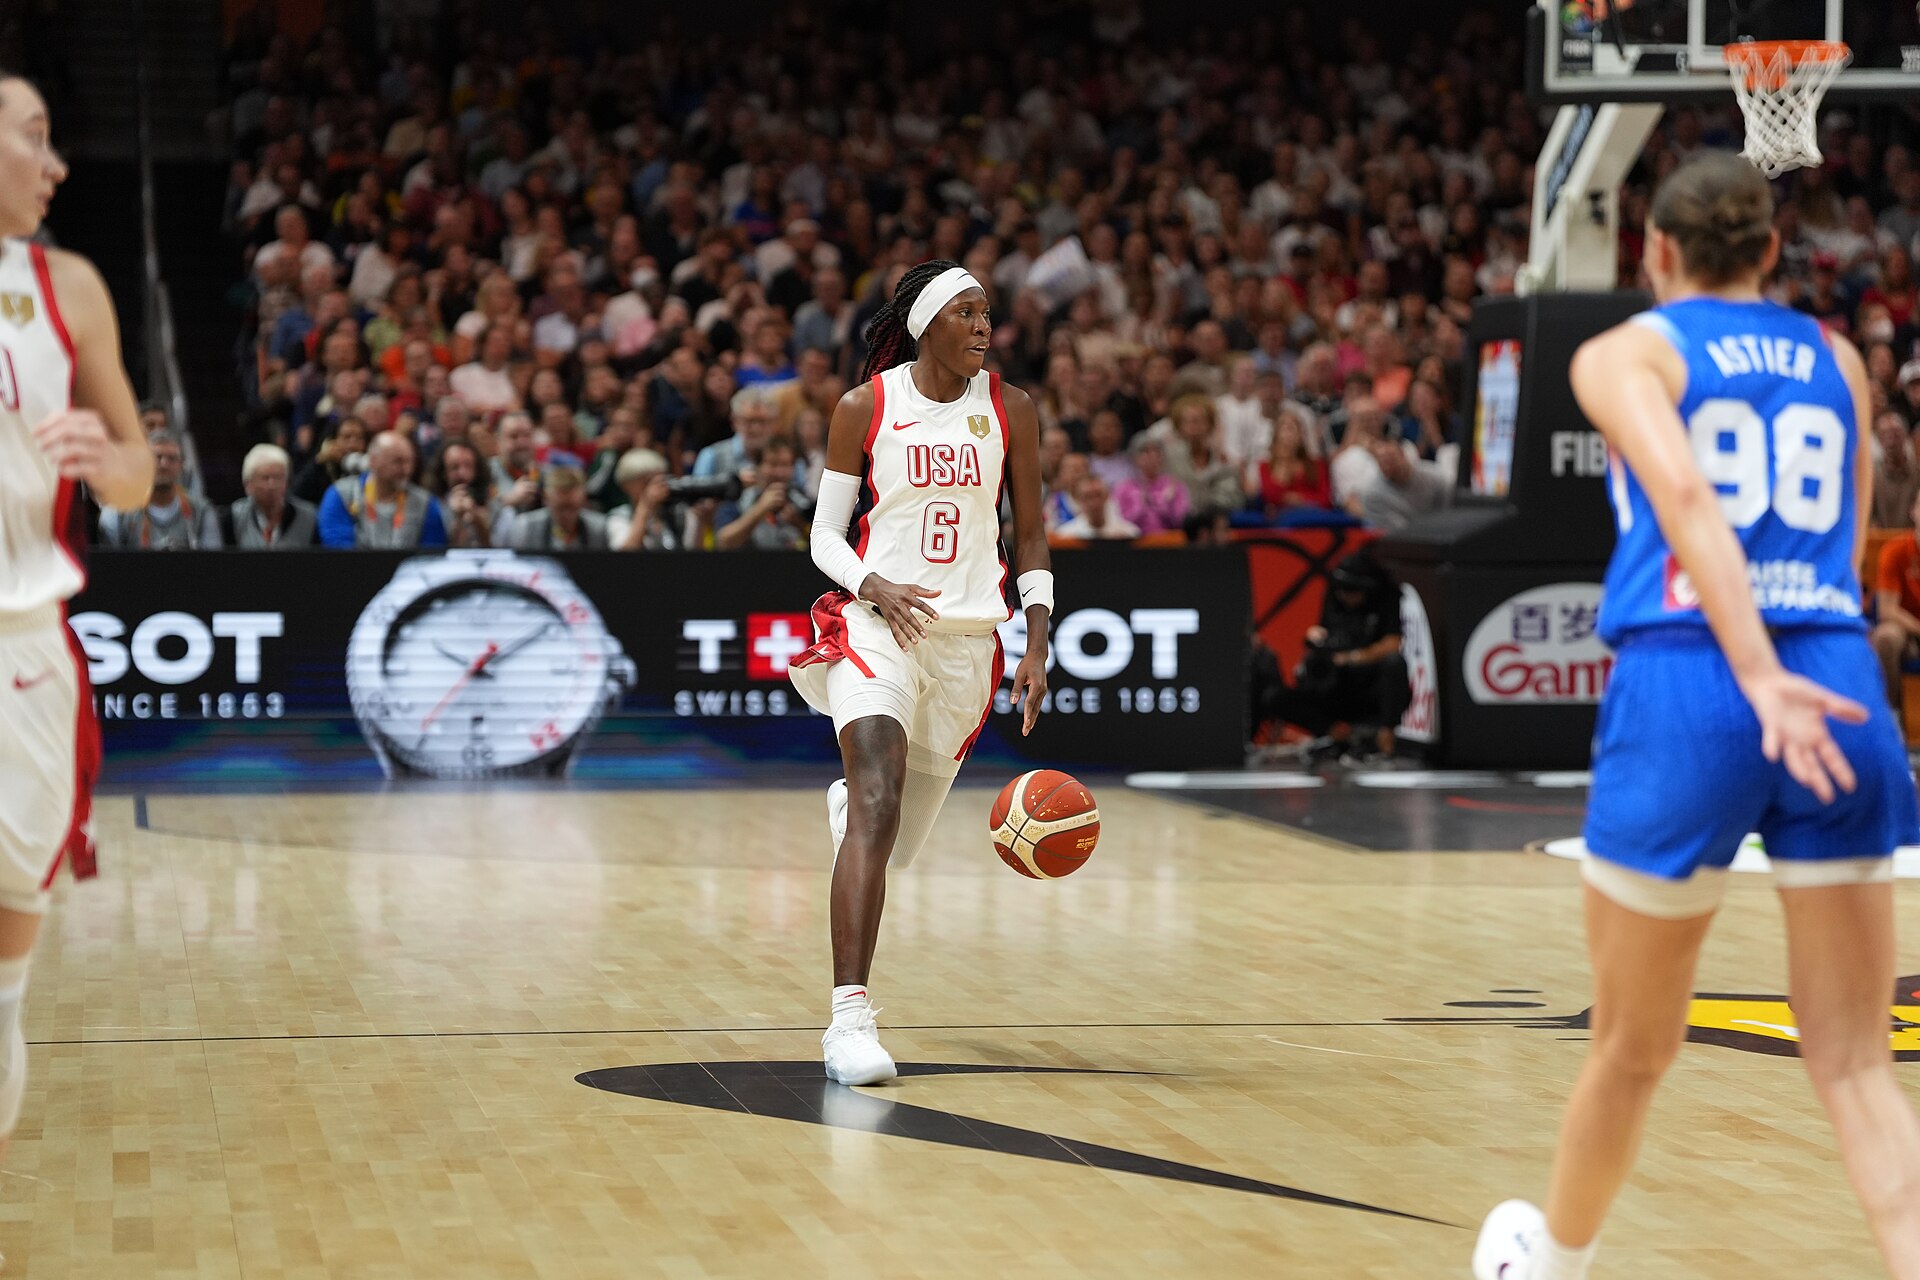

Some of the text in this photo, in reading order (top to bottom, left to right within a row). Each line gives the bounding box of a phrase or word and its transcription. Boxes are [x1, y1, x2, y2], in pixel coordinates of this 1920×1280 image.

[1705, 333, 1816, 384] ASTIER
[907, 444, 981, 487] USA
[1688, 398, 1847, 535] 98
[921, 501, 960, 563] 6
[674, 690, 789, 716] SWISS
